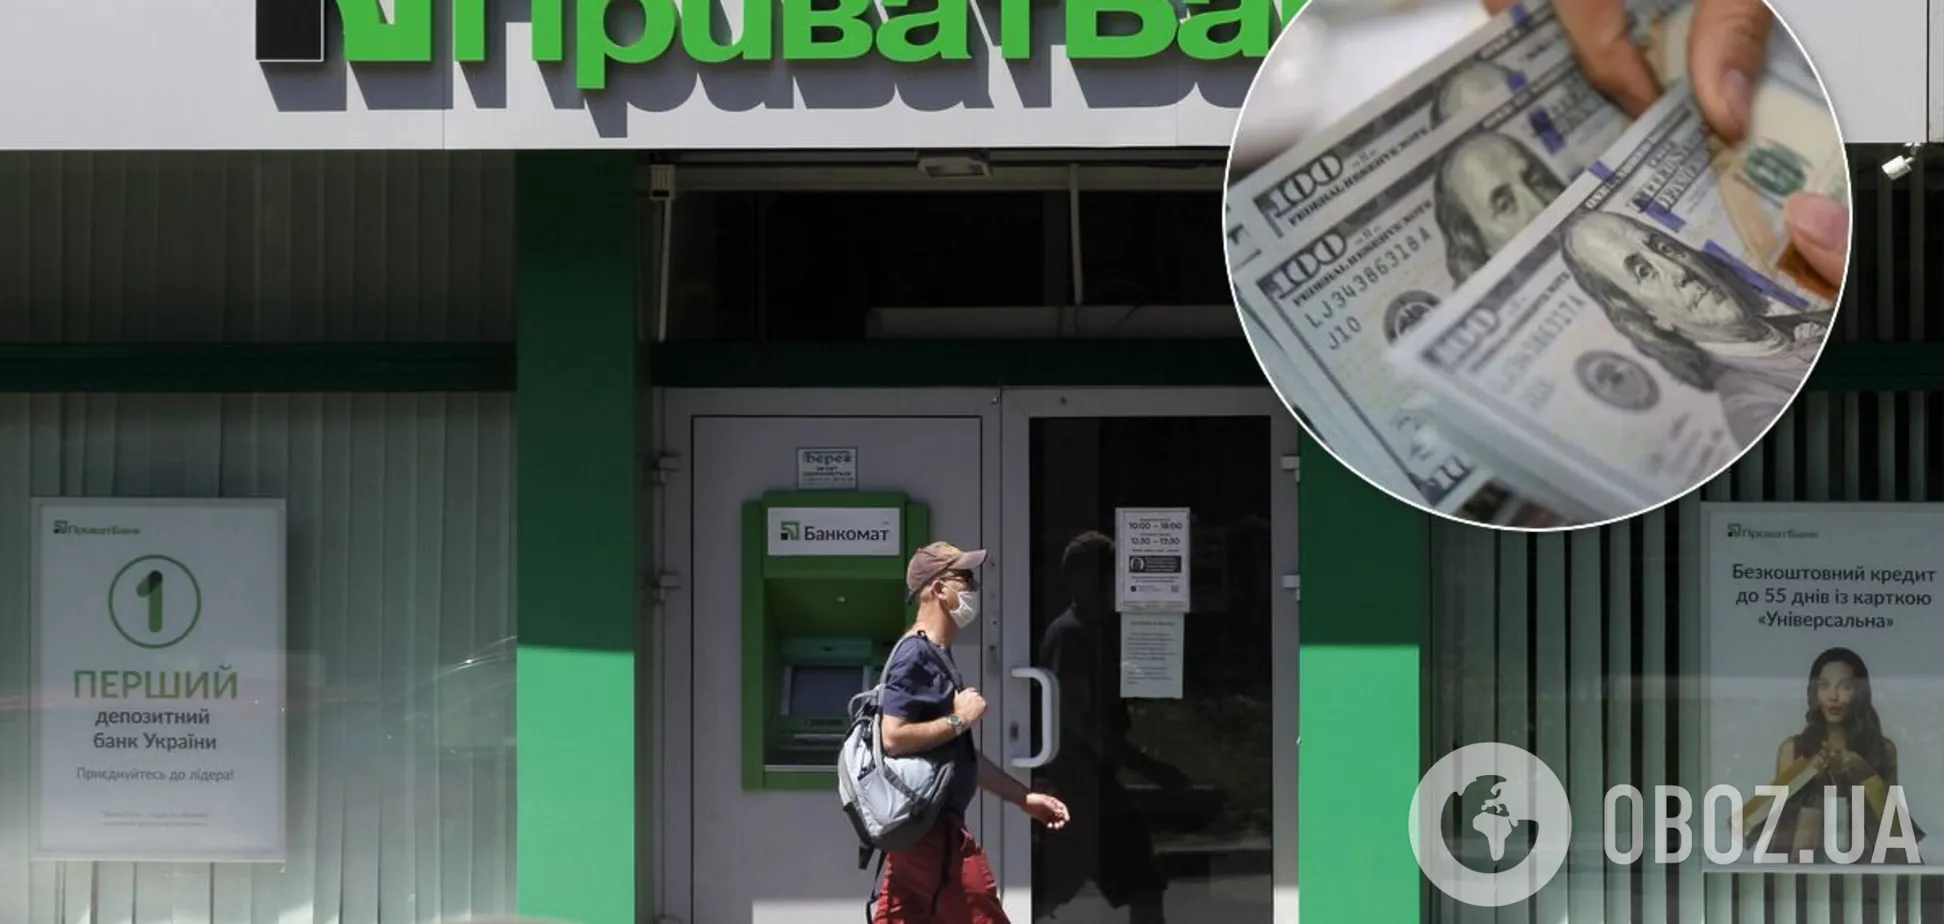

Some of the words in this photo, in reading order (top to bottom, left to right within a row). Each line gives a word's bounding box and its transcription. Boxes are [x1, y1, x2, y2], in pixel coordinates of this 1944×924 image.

[455, 0, 1308, 90] ПриватБа
[1267, 152, 1344, 219] 100
[1271, 232, 1347, 300] 100
[1328, 315, 1363, 351] J10
[804, 525, 891, 541] Банкомат
[1732, 564, 1865, 581] Безкоштовний
[1870, 570, 1937, 584] кредит
[1736, 591, 1759, 605] до
[1765, 588, 1787, 604] 55
[1791, 590, 1829, 606] днів
[1835, 589, 1849, 605] із
[1853, 594, 1932, 608] карткою
[1758, 611, 1894, 630] «Універсальна»
[74, 665, 238, 699] ПЕРШИЙ
[95, 709, 210, 727] депозитний
[93, 732, 138, 749] банк
[143, 733, 217, 752] України
[76, 767, 164, 781] Приєднуйтесь
[169, 771, 185, 782] до
[190, 768, 234, 782] лідера!
